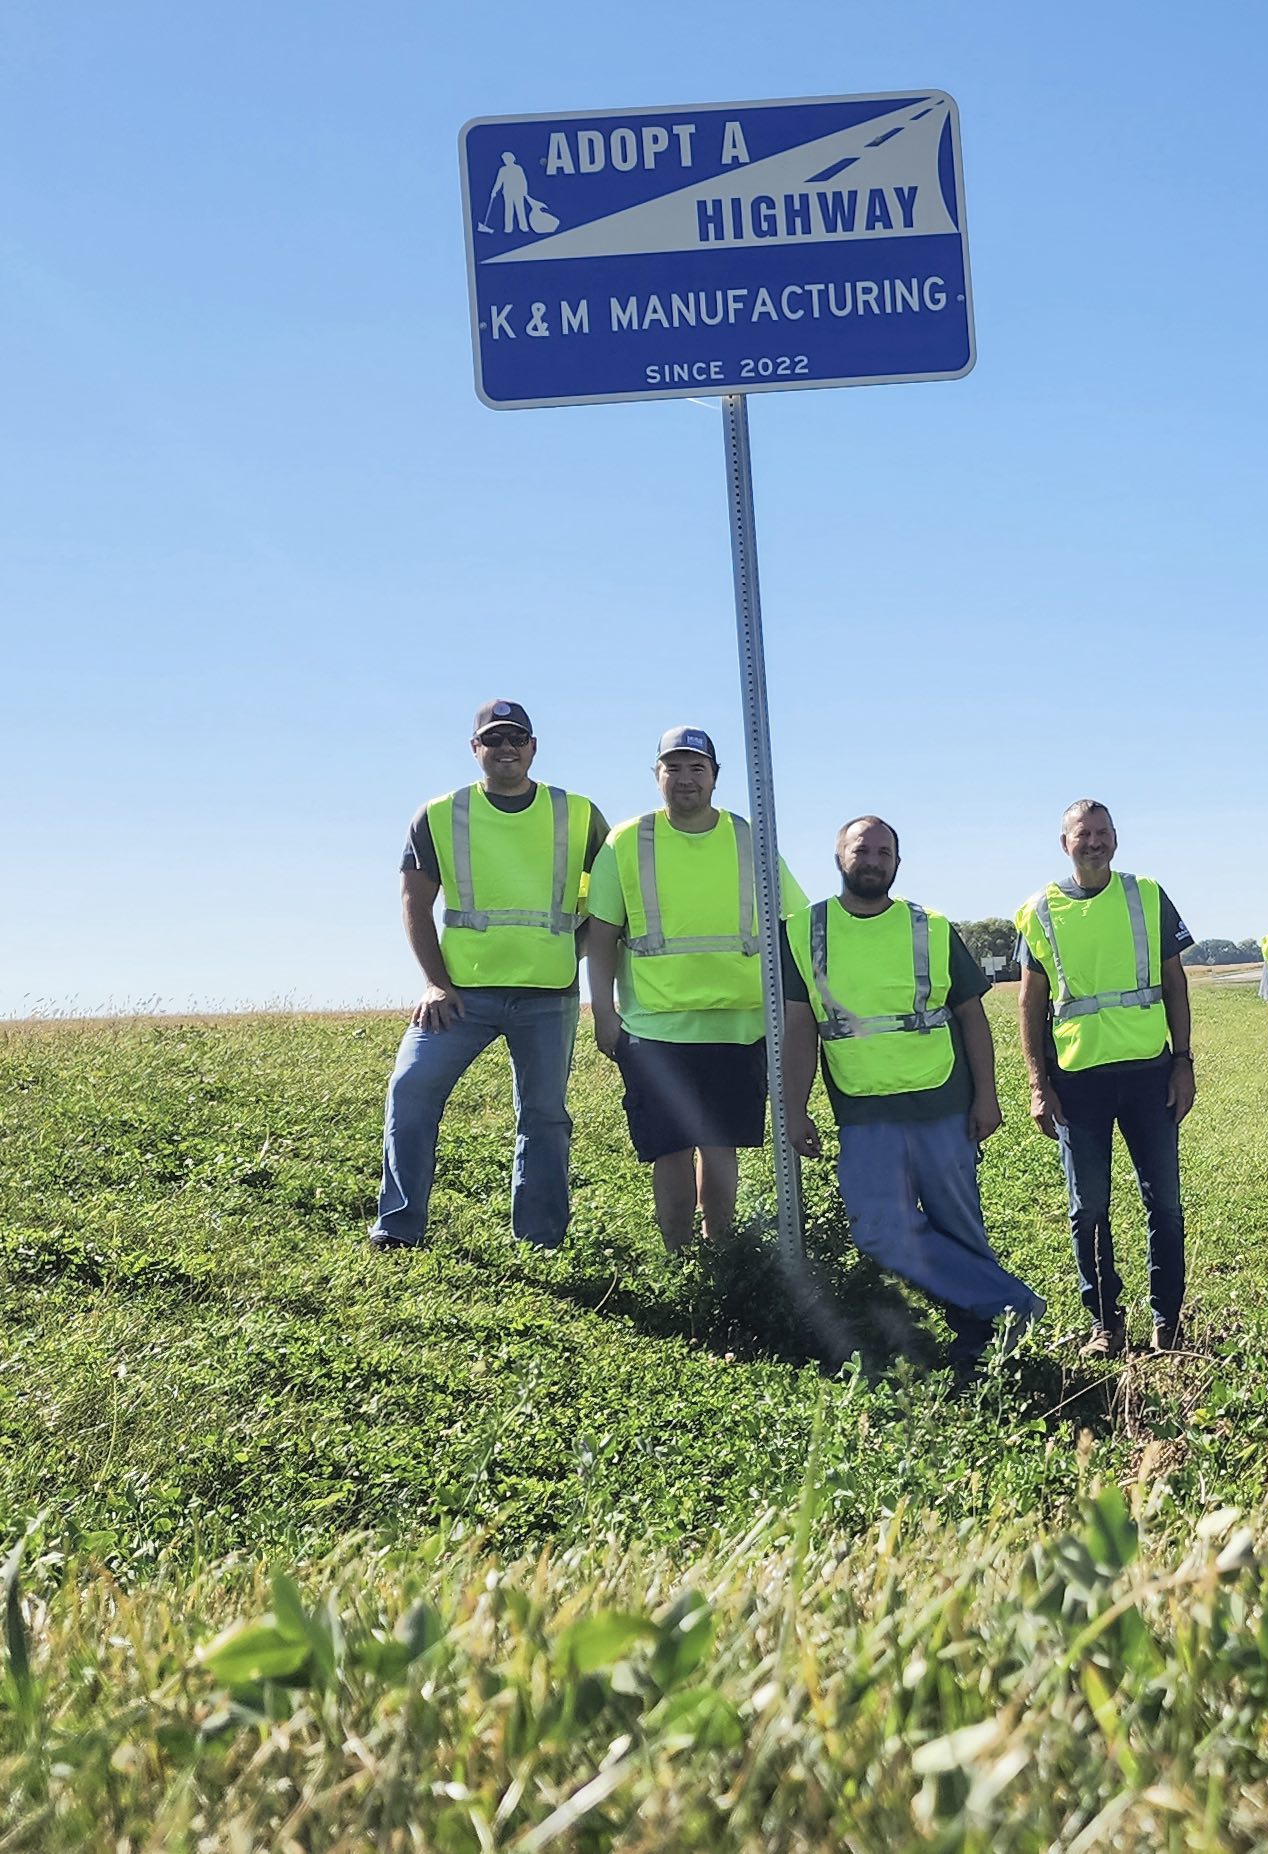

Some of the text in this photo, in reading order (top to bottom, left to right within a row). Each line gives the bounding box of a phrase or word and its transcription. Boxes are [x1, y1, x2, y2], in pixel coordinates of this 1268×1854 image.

[546, 121, 750, 175] ADOPT A
[696, 186, 919, 242] HIGHWAY
[490, 276, 947, 340] K & M MANUFACTURING
[646, 355, 809, 384] SINCE 2022
